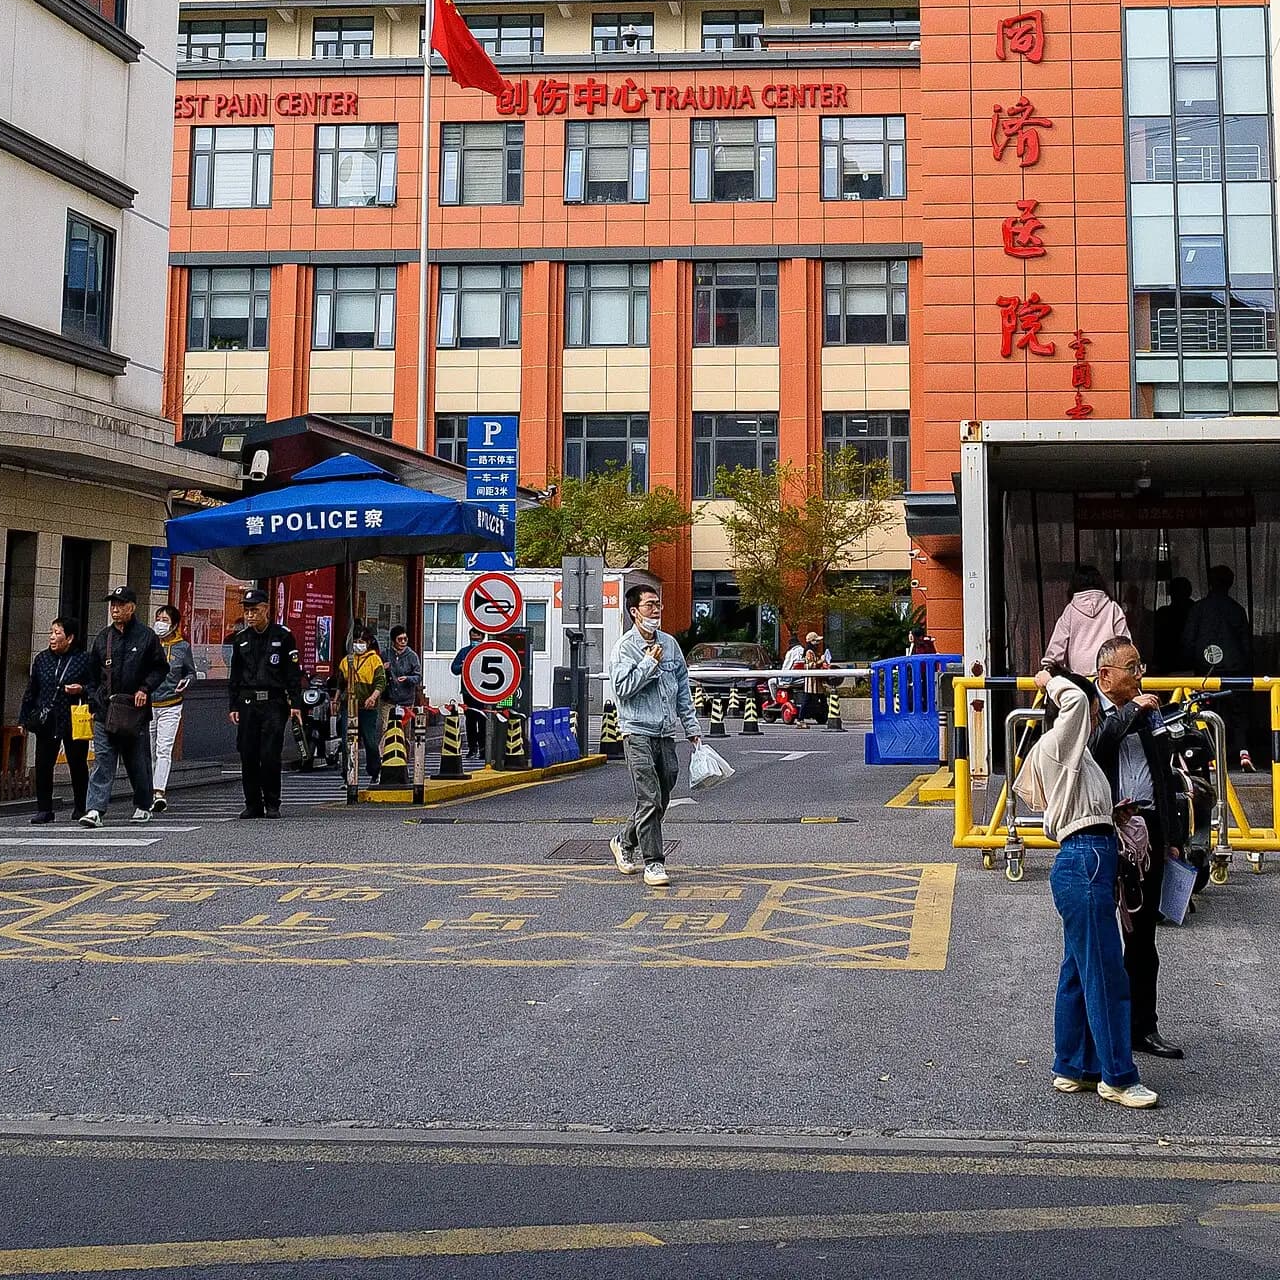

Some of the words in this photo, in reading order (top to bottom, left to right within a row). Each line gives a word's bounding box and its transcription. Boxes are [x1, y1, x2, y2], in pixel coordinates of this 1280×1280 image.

[214, 92, 269, 118] PAIN
[274, 91, 359, 117] CENTER
[495, 77, 649, 116] 创伤中心
[651, 83, 756, 111] TRAUMA
[761, 82, 849, 109] CENTER
[482, 421, 503, 446] P
[470, 455, 516, 465] 一路不停车
[473, 473, 510, 483] 一车一杆
[476, 486, 509, 497] 间距3米
[246, 516, 264, 535] 警
[270, 510, 358, 533] POLICE
[364, 509, 384, 529] 察
[480, 656, 505, 691] 5
[105, 886, 747, 902] 消防车道
[44, 911, 732, 930] 禁止占用
